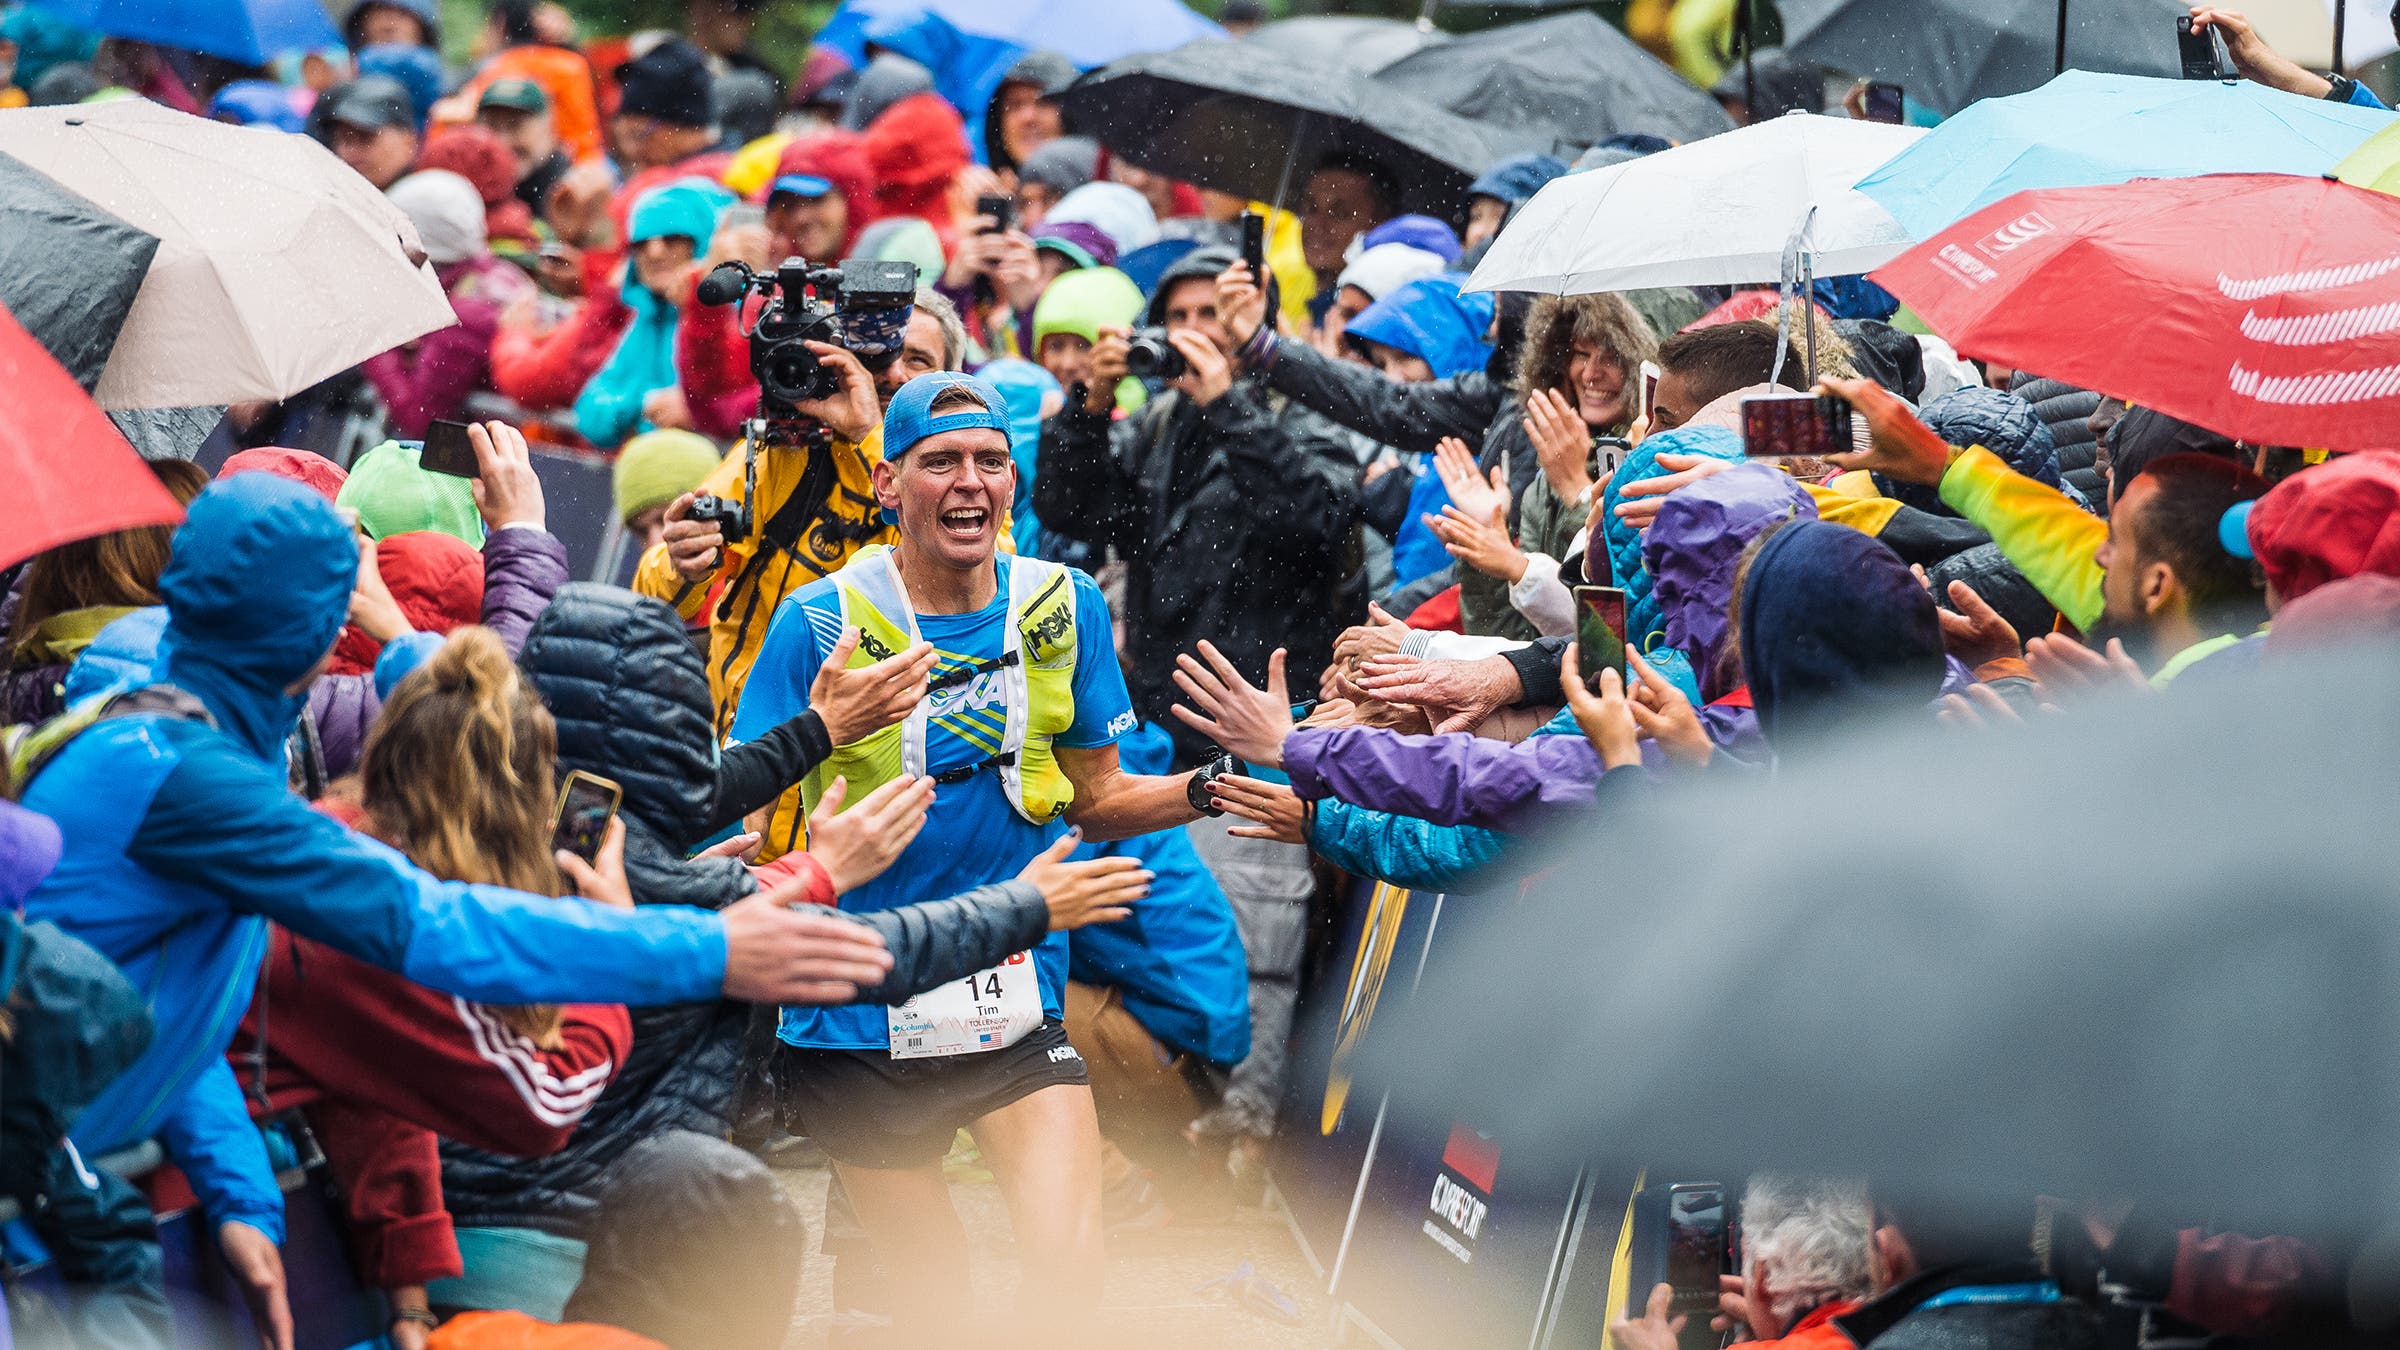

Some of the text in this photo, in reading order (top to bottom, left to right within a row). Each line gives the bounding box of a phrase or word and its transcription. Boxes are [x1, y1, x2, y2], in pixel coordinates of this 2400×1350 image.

[927, 669, 1008, 718] OKA
[965, 973, 1003, 1001] 14
[976, 1005, 999, 1016] Tim
